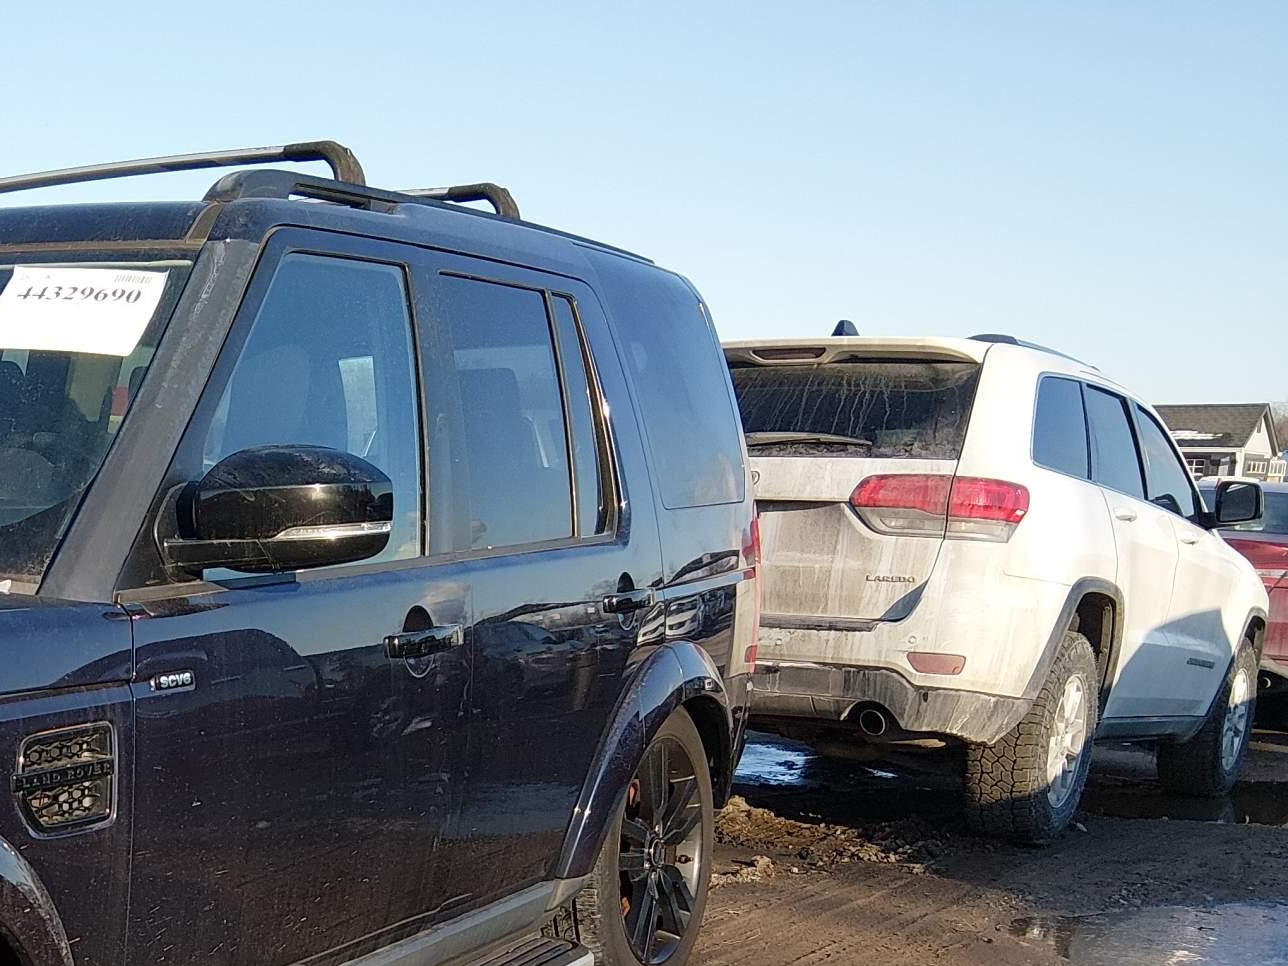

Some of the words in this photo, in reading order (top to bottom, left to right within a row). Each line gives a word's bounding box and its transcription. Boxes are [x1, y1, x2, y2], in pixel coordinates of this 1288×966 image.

[17, 286, 142, 304] 44329690
[865, 574, 916, 584] LAREDO
[159, 672, 192, 688] SCV6
